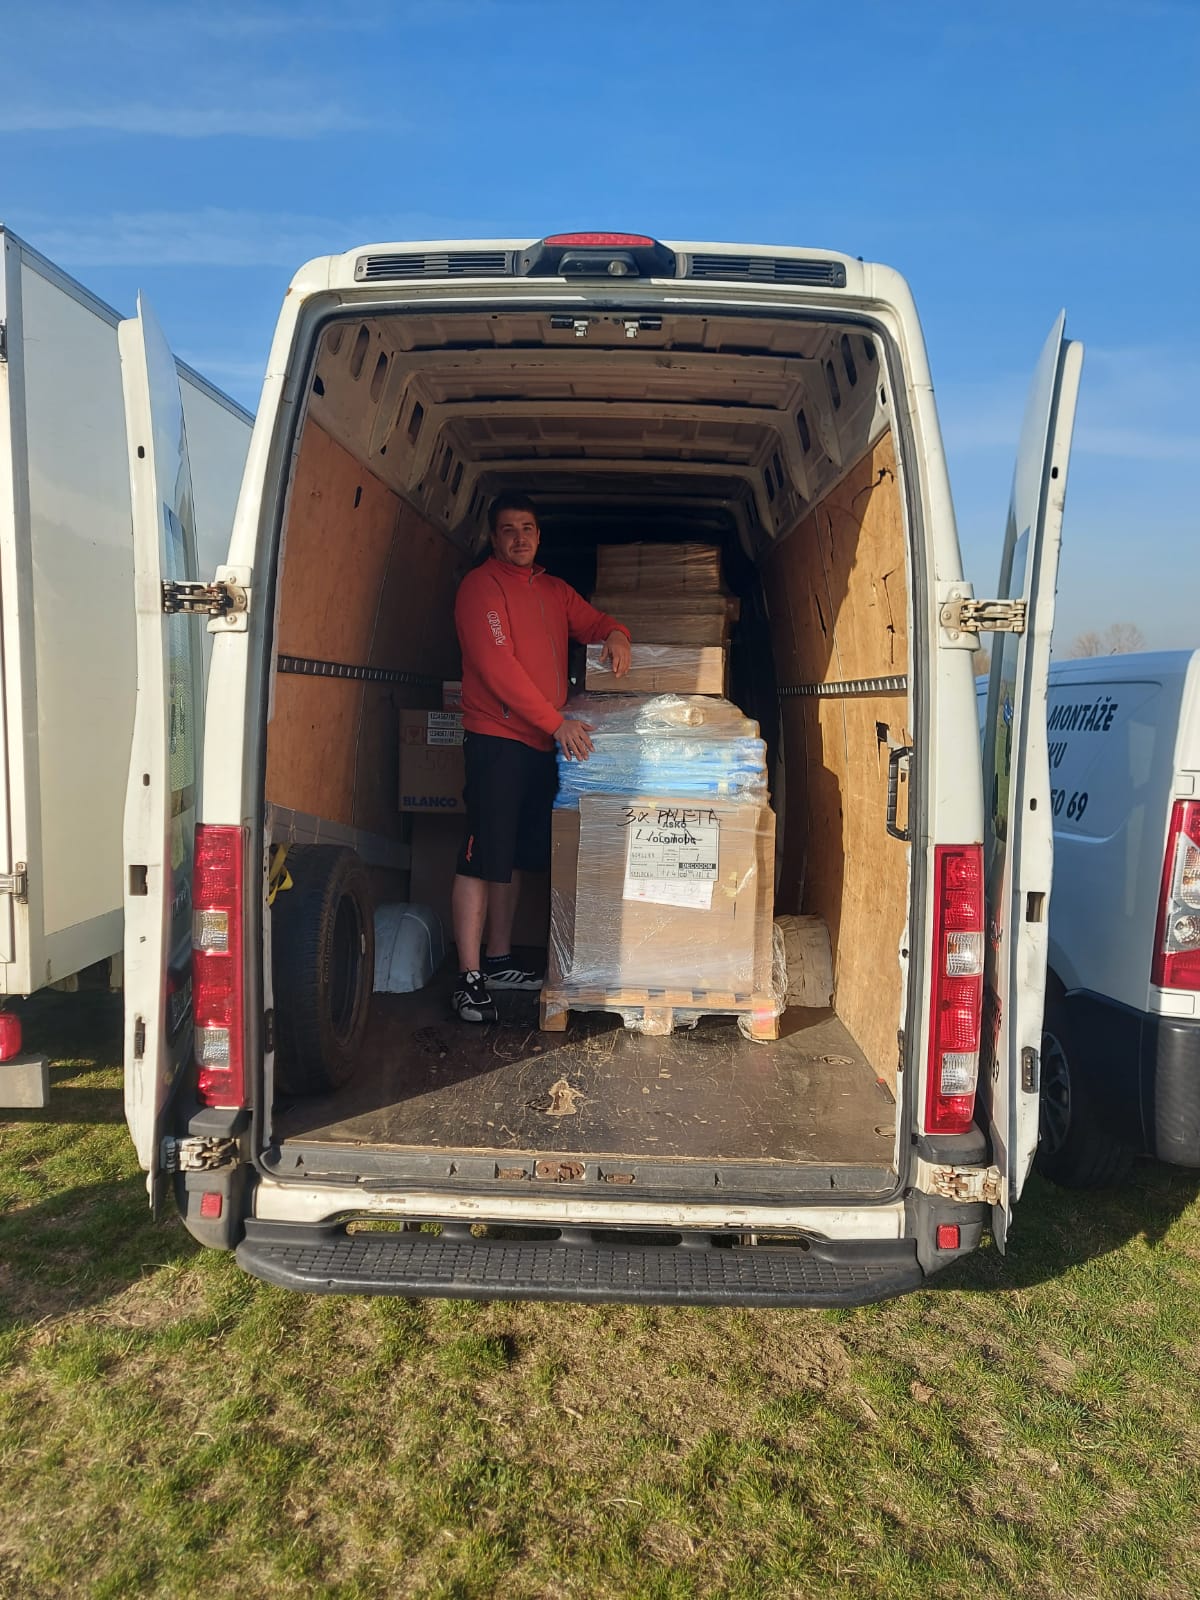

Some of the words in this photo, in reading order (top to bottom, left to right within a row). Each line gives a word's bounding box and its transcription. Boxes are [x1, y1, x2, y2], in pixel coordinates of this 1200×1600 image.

[487, 610, 506, 646] ASKO
[1047, 696, 1119, 731] MONTÁŽE
[402, 796, 457, 807] BLANCO
[1066, 791, 1089, 822] 69
[662, 821, 687, 829] ASKO
